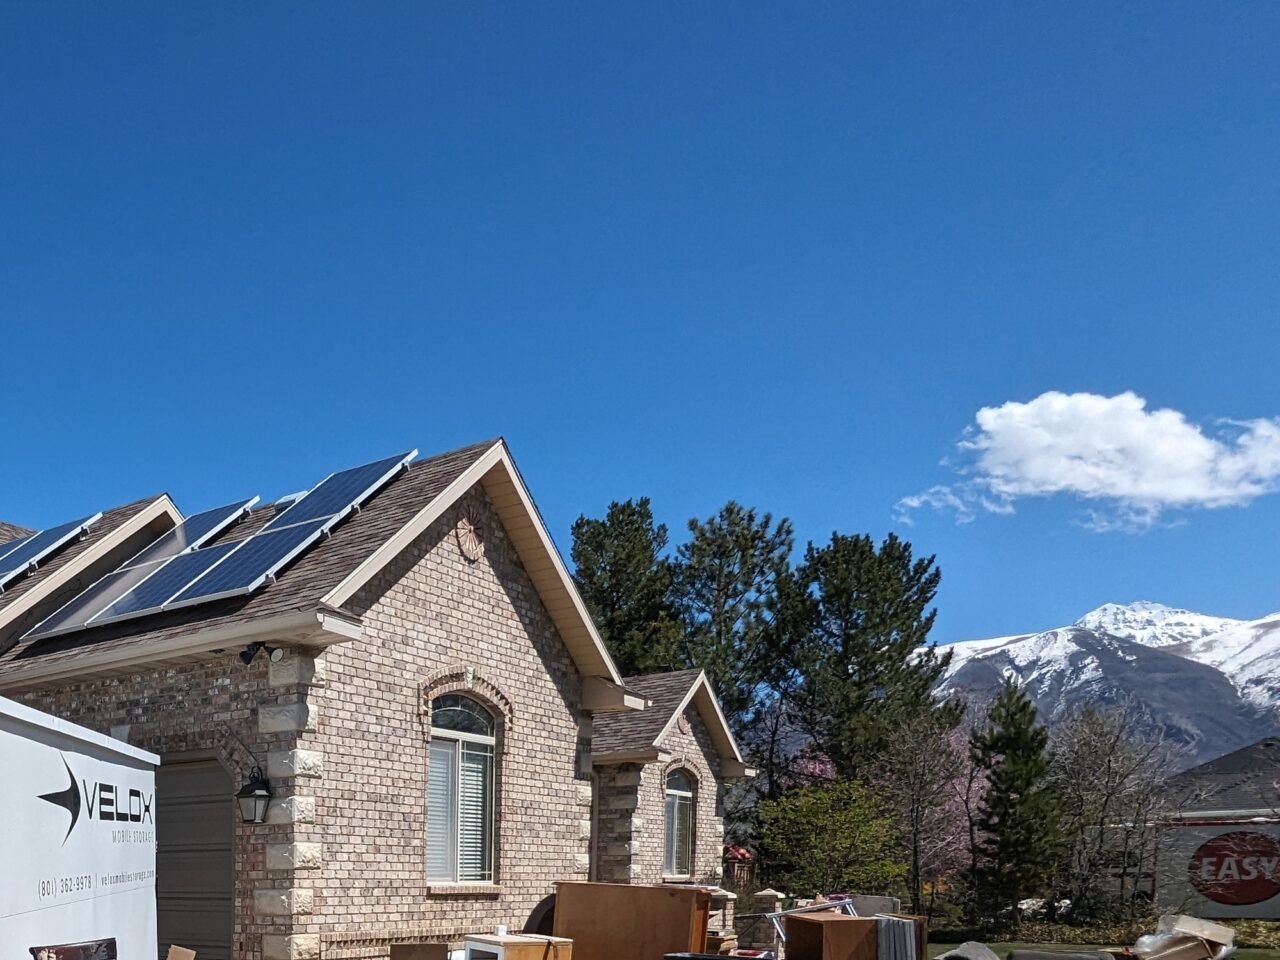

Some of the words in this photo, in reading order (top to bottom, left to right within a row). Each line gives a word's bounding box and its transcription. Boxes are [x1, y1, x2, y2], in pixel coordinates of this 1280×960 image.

[82, 779, 153, 824] VELOX
[112, 830, 131, 843] MOBILE
[1201, 857, 1280, 880] EASY
[38, 878, 57, 901] (801)
[60, 875, 92, 894] 362-9978
